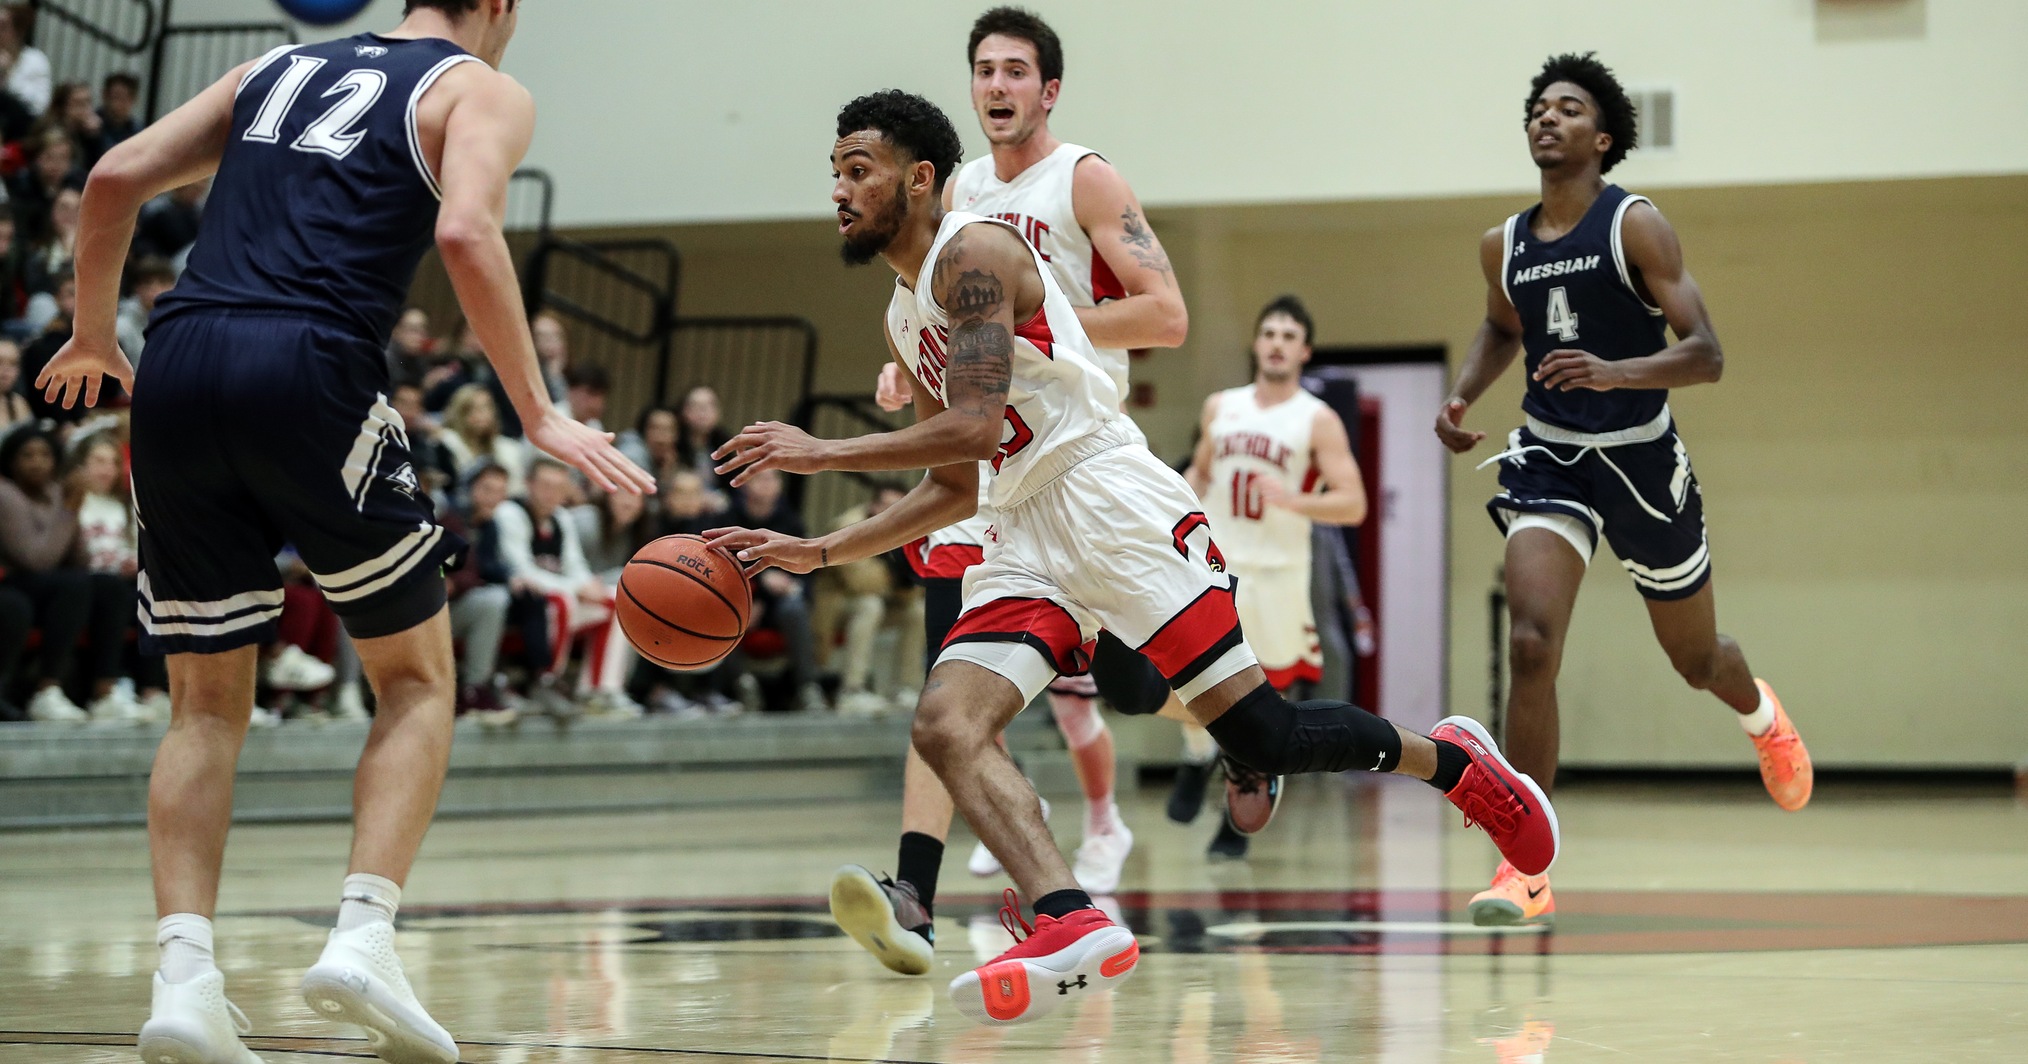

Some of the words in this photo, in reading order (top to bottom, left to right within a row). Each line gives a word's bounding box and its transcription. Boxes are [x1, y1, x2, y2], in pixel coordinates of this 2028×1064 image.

[241, 54, 388, 161] 12
[1513, 255, 1600, 285] MESSIAH
[1547, 286, 1580, 342] 4
[1231, 469, 1264, 521] 10
[676, 554, 714, 579] ROCK
